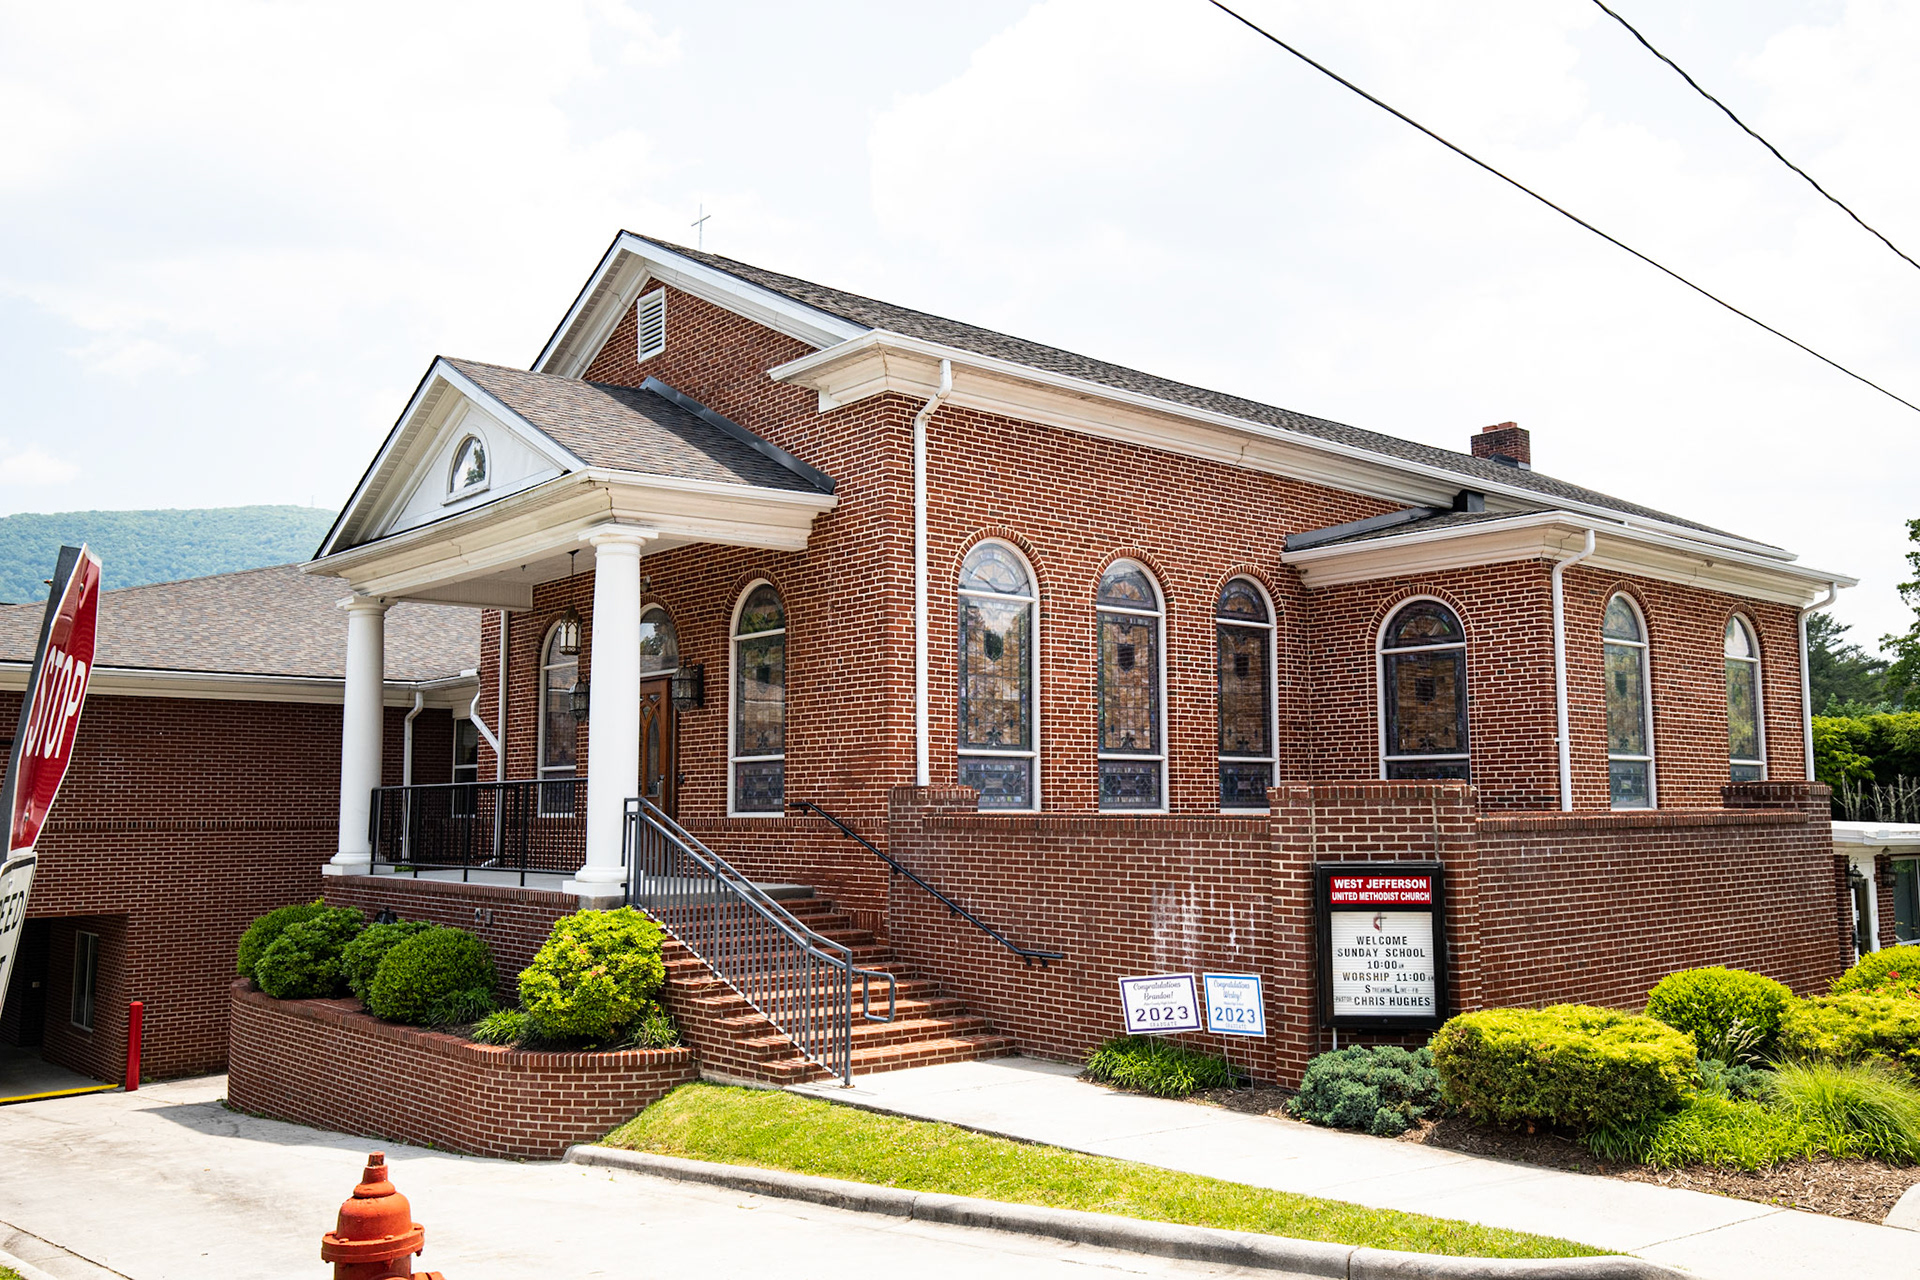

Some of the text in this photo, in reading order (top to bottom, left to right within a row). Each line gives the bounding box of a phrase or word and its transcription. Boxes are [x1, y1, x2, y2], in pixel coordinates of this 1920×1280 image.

[26, 645, 86, 759] STOP
[1334, 879, 1427, 889] WEST JEFFERSON
[1332, 892, 1430, 901] UNITED METHODIST CHURCH
[1356, 936, 1408, 945] WELCOME
[1337, 948, 1425, 958] SUNDAY SCHOOL
[1367, 960, 1397, 969] 10:00
[1342, 972, 1390, 981] WORSHIP
[1396, 972, 1426, 982] 11:00
[1133, 981, 1181, 992] Congratulations
[1354, 996, 1385, 1006] CHRIS
[1389, 996, 1431, 1006] HUGHES
[1135, 1006, 1188, 1022] 2023
[1215, 1006, 1256, 1024] 2023
